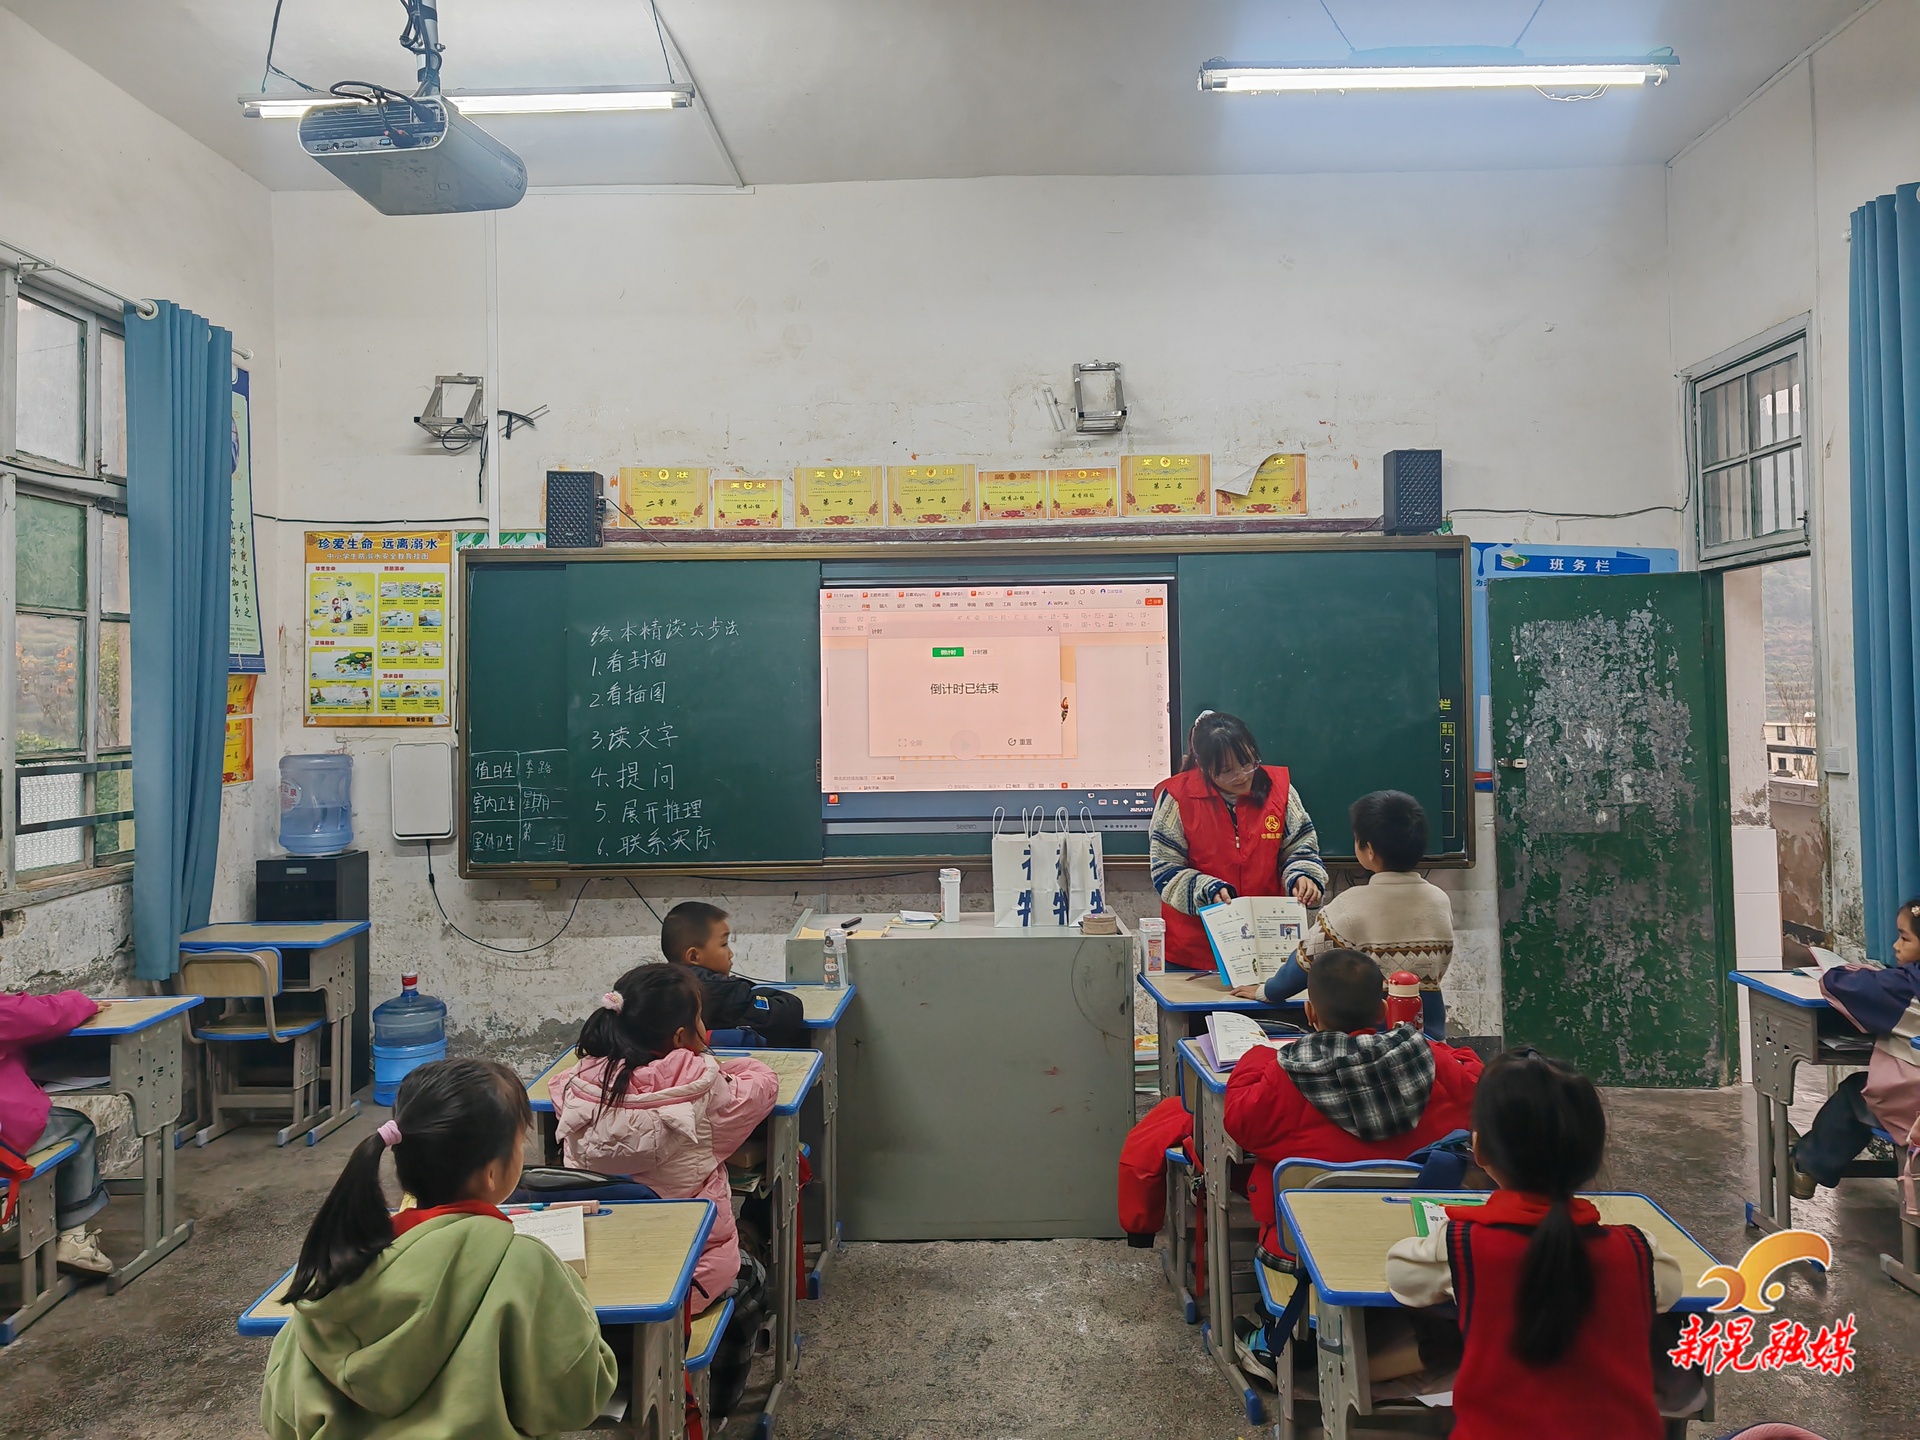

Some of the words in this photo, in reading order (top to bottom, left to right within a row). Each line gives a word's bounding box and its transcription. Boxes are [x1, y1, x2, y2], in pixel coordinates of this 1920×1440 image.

[646, 498, 677, 508] 二等奖
[823, 497, 854, 506] 第一名
[916, 496, 946, 504] 第一名
[317, 537, 374, 550] 珍爱生命
[381, 537, 439, 550] 远离溺水
[1549, 558, 1611, 573] 班务栏
[590, 617, 741, 647] 绘本精读六步法
[930, 682, 1000, 695] 倒计时已结束
[1018, 738, 1033, 746] 重置
[1444, 742, 1451, 754] 5
[474, 760, 516, 780] 值日生
[1444, 767, 1450, 778] 5
[473, 791, 516, 814] 室内卫生
[522, 790, 564, 813] 星期一
[473, 830, 515, 852] 室外卫生
